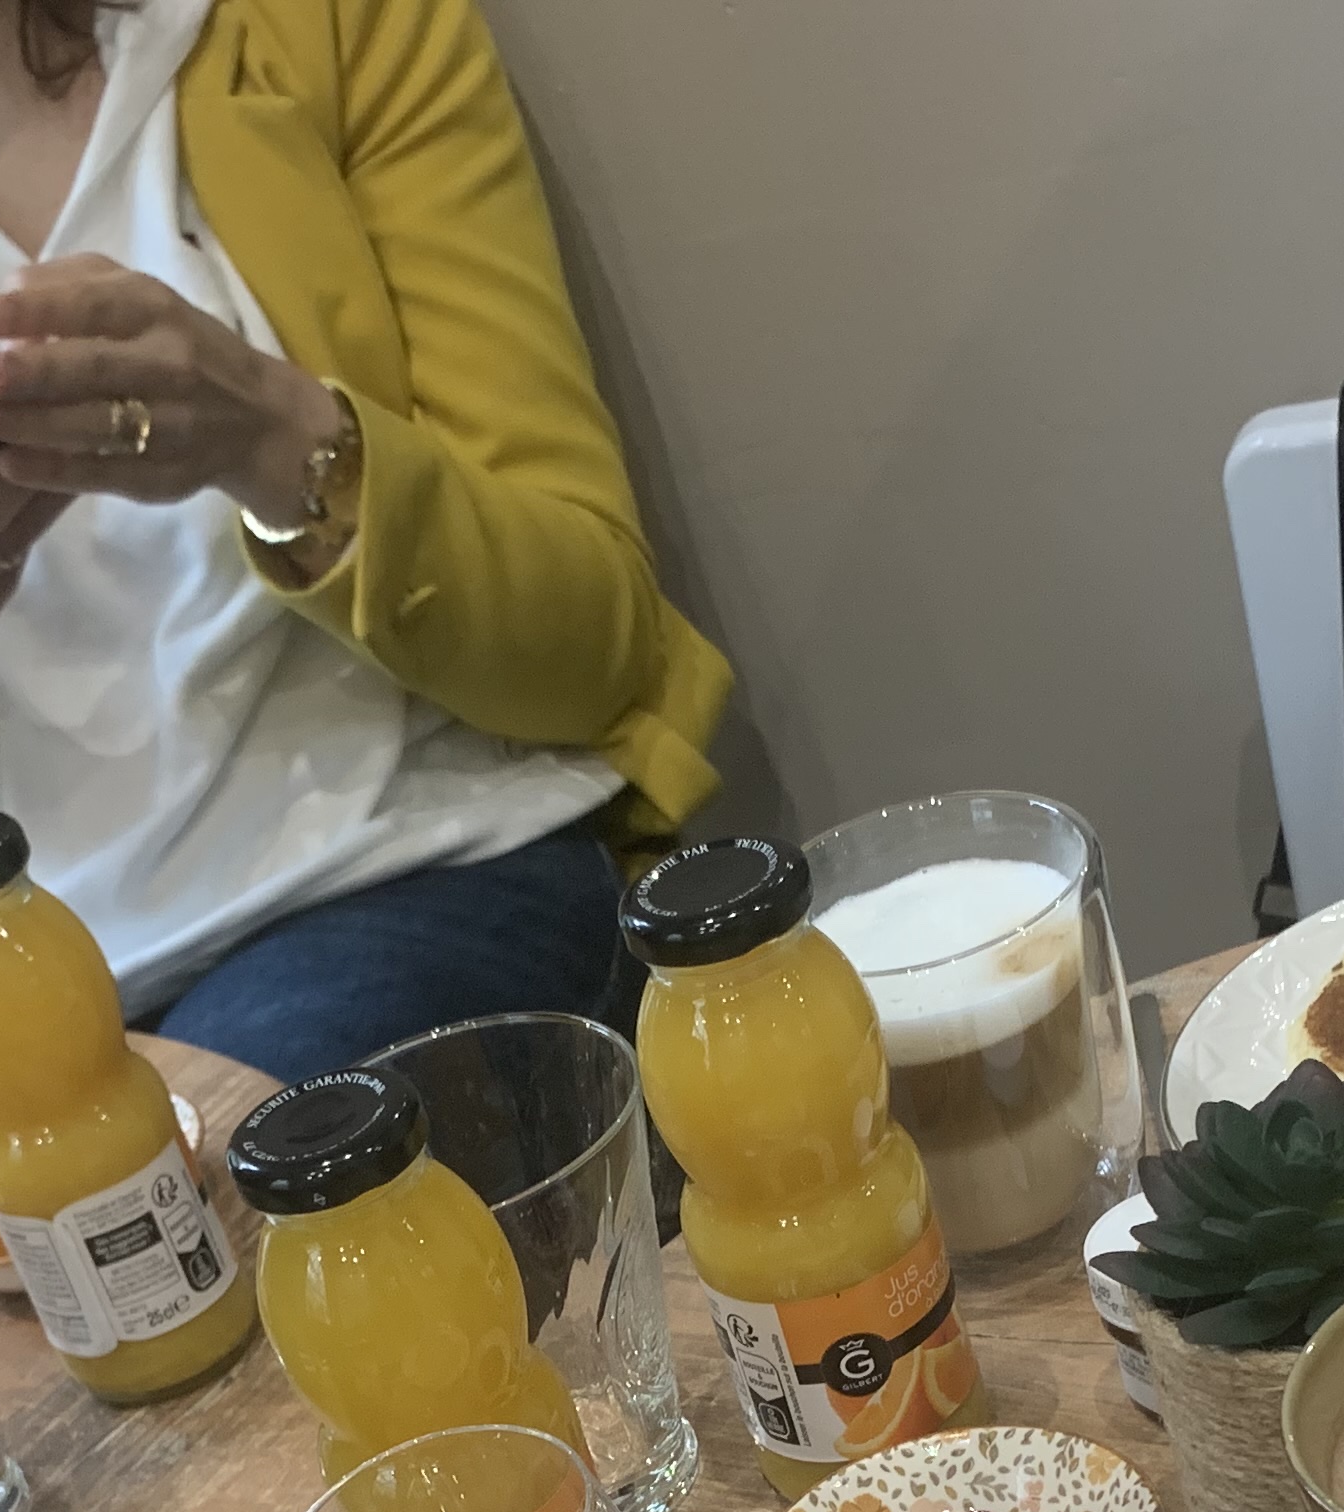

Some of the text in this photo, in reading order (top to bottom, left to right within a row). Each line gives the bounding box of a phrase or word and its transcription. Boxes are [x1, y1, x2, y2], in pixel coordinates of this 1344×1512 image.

[884, 1264, 919, 1299] Jus
[840, 1349, 875, 1379] G
[841, 1372, 885, 1392] GILBERT
